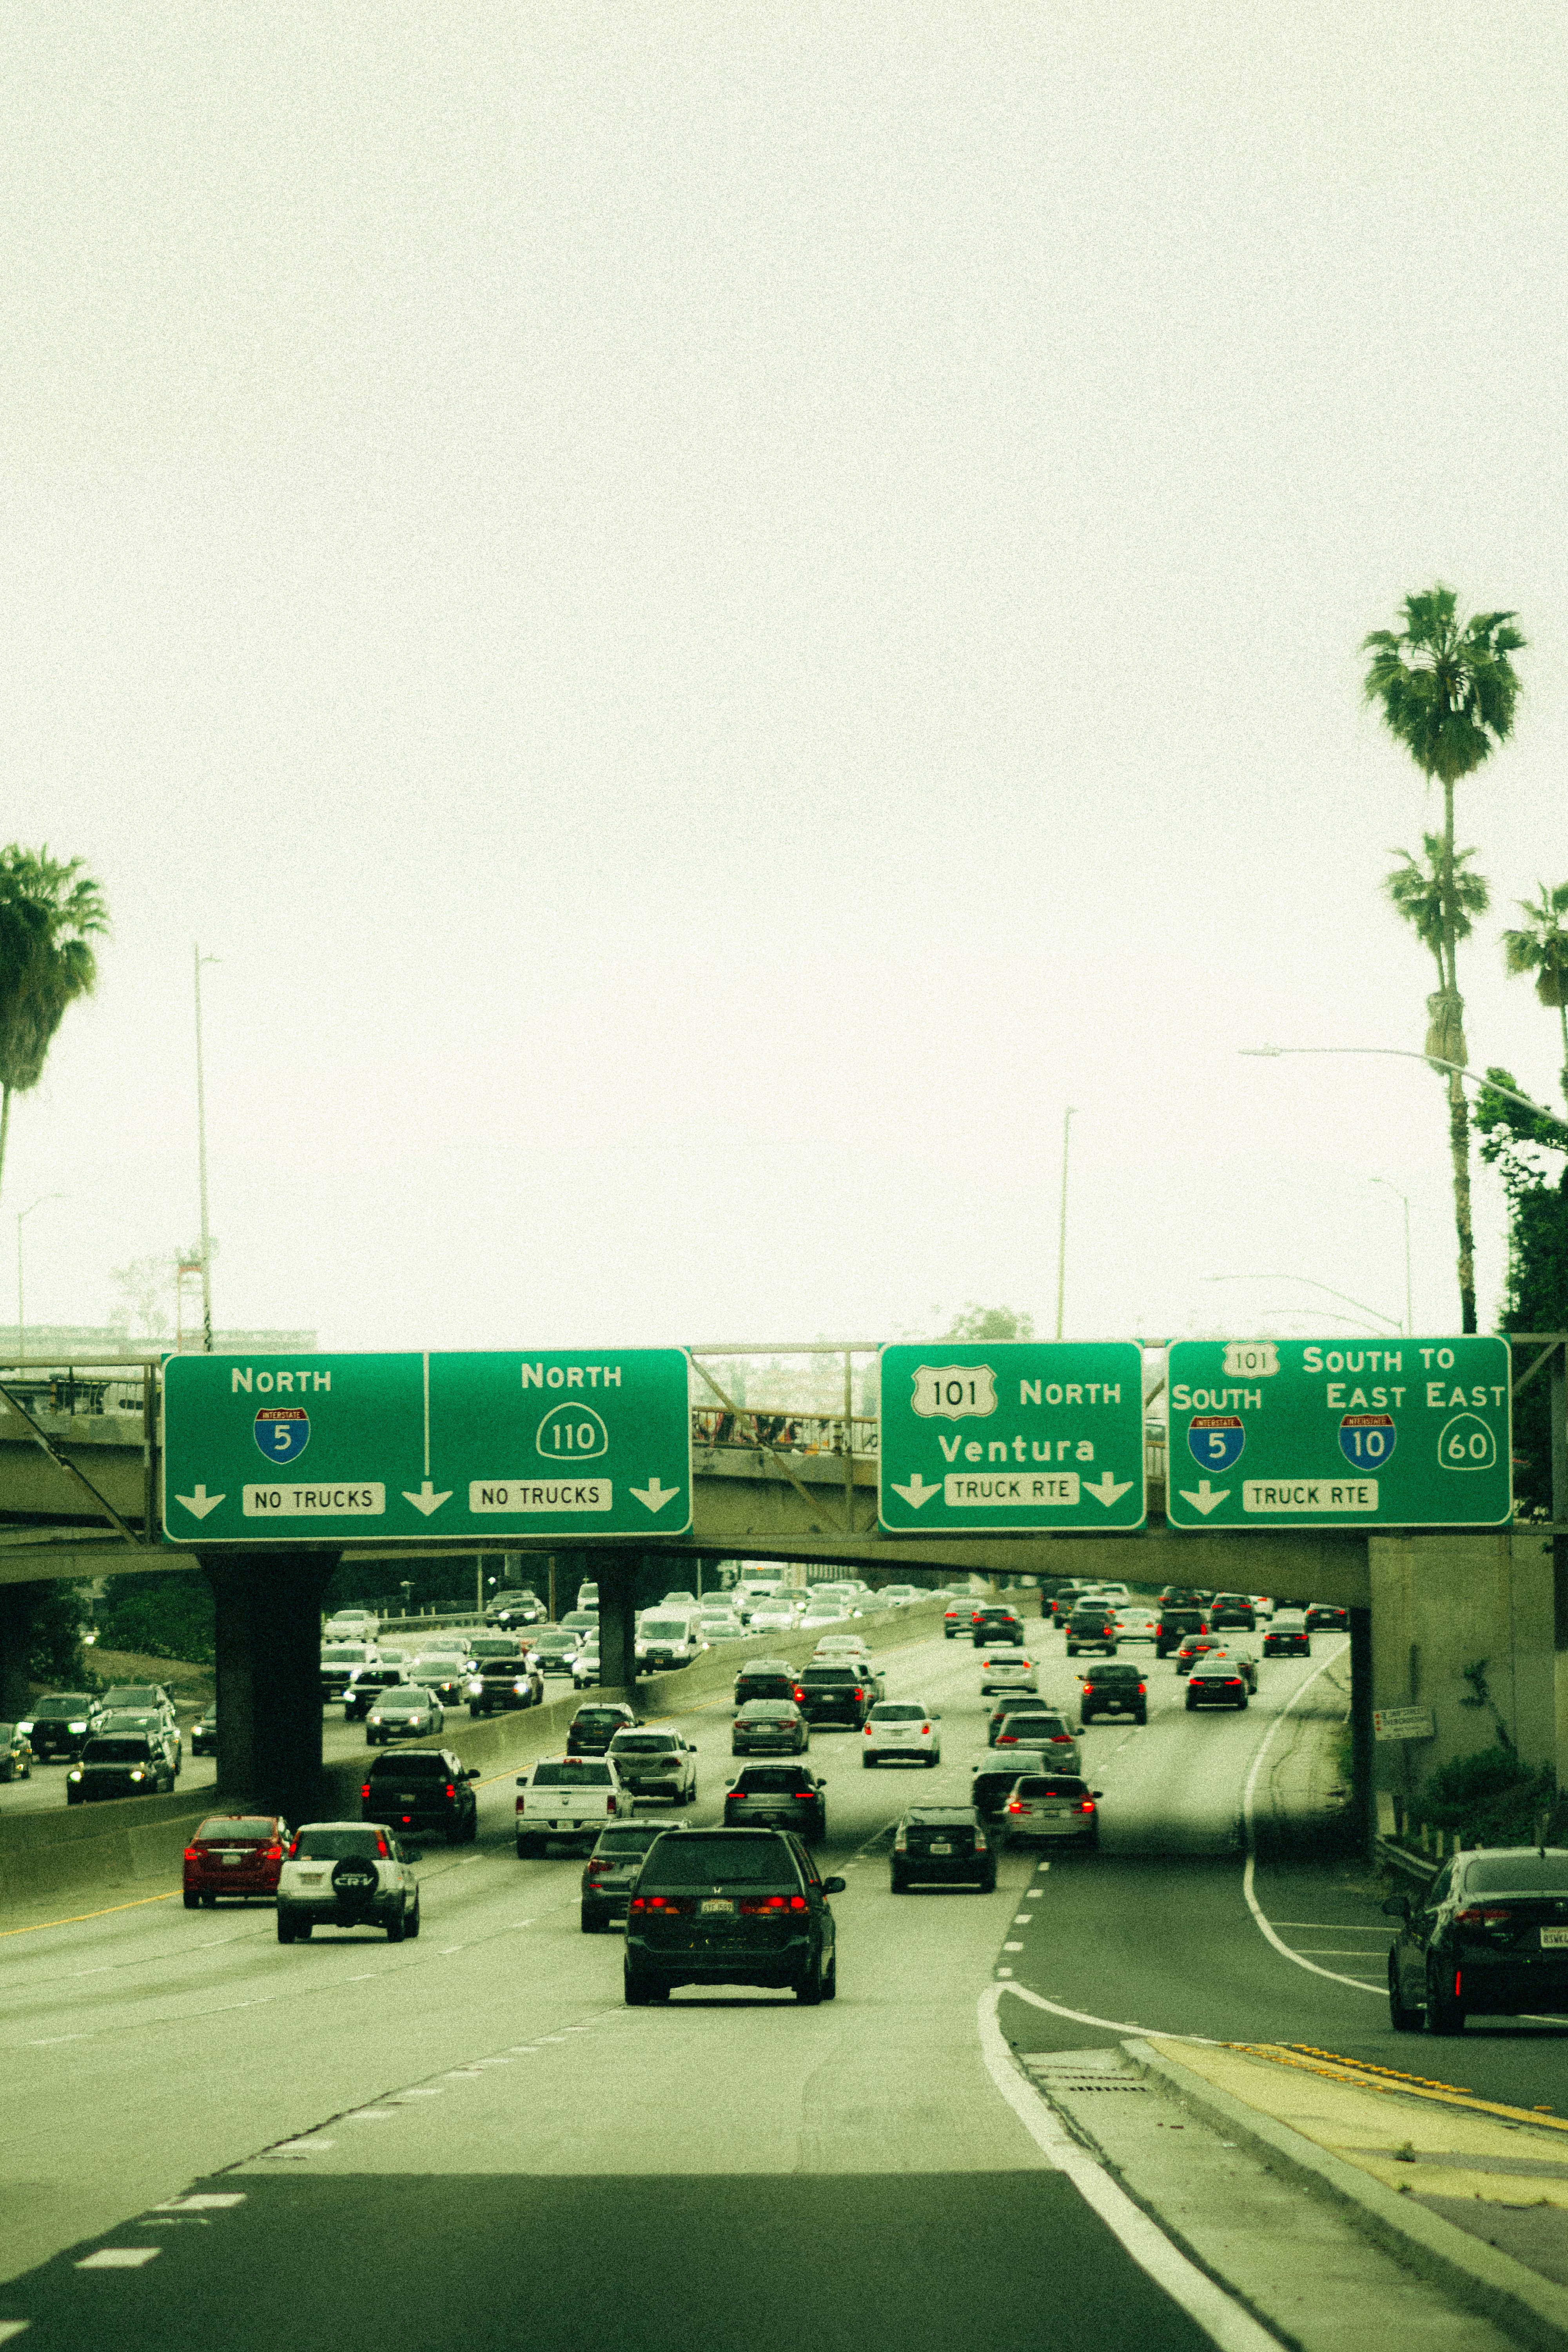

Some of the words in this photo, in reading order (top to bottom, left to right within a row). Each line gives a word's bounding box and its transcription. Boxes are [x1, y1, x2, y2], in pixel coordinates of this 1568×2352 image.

[1237, 1352, 1267, 1369] 101
[1303, 1347, 1402, 1372] SOUTH
[1419, 1348, 1455, 1369] TO
[232, 1367, 331, 1392] NORTH
[521, 1363, 621, 1388] NORTH
[934, 1381, 975, 1405] 101
[1020, 1379, 1120, 1405] NORTH
[1172, 1384, 1261, 1410] SOUTH
[1327, 1383, 1406, 1408] EAST
[1426, 1382, 1505, 1407] EAST
[274, 1425, 291, 1450] 5
[553, 1423, 595, 1449] 110
[938, 1435, 1094, 1462] Ventura
[1209, 1432, 1226, 1458] 5
[1354, 1431, 1385, 1457] 10
[1448, 1433, 1487, 1459] 60
[255, 1491, 281, 1508] NO
[293, 1490, 373, 1508] TRUCKS
[482, 1488, 508, 1505] NO
[520, 1486, 599, 1504] TRUCKS
[955, 1481, 1021, 1497] TRUCK
[1033, 1480, 1070, 1497] RTE
[1253, 1486, 1319, 1504] TRUCK
[1331, 1486, 1368, 1504] RTE
